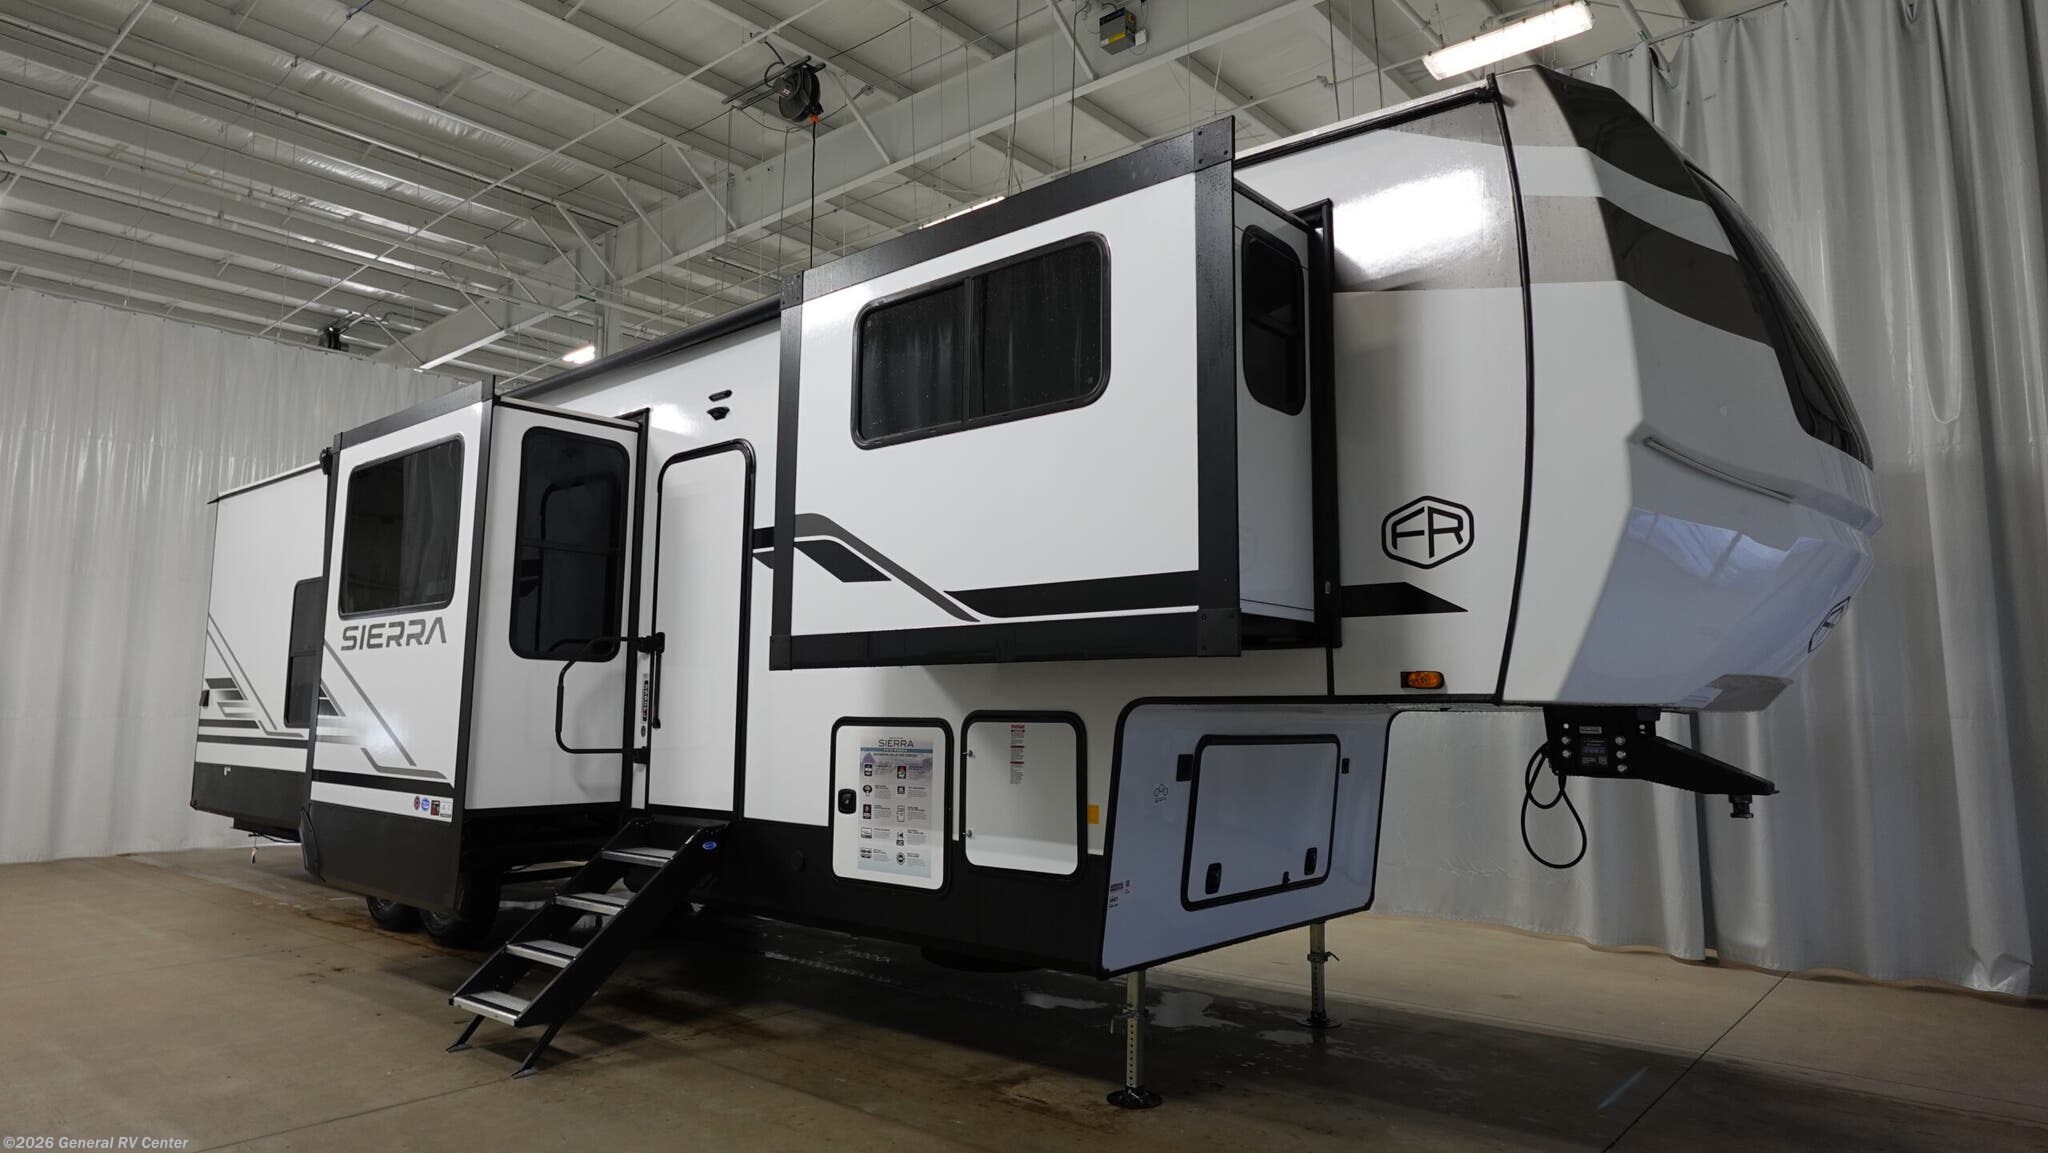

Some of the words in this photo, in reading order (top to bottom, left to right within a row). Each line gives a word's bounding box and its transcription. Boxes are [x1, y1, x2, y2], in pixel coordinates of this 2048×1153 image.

[1391, 506, 1464, 559] FR
[341, 616, 447, 651] SIERRA
[878, 739, 914, 748] SIERRA
